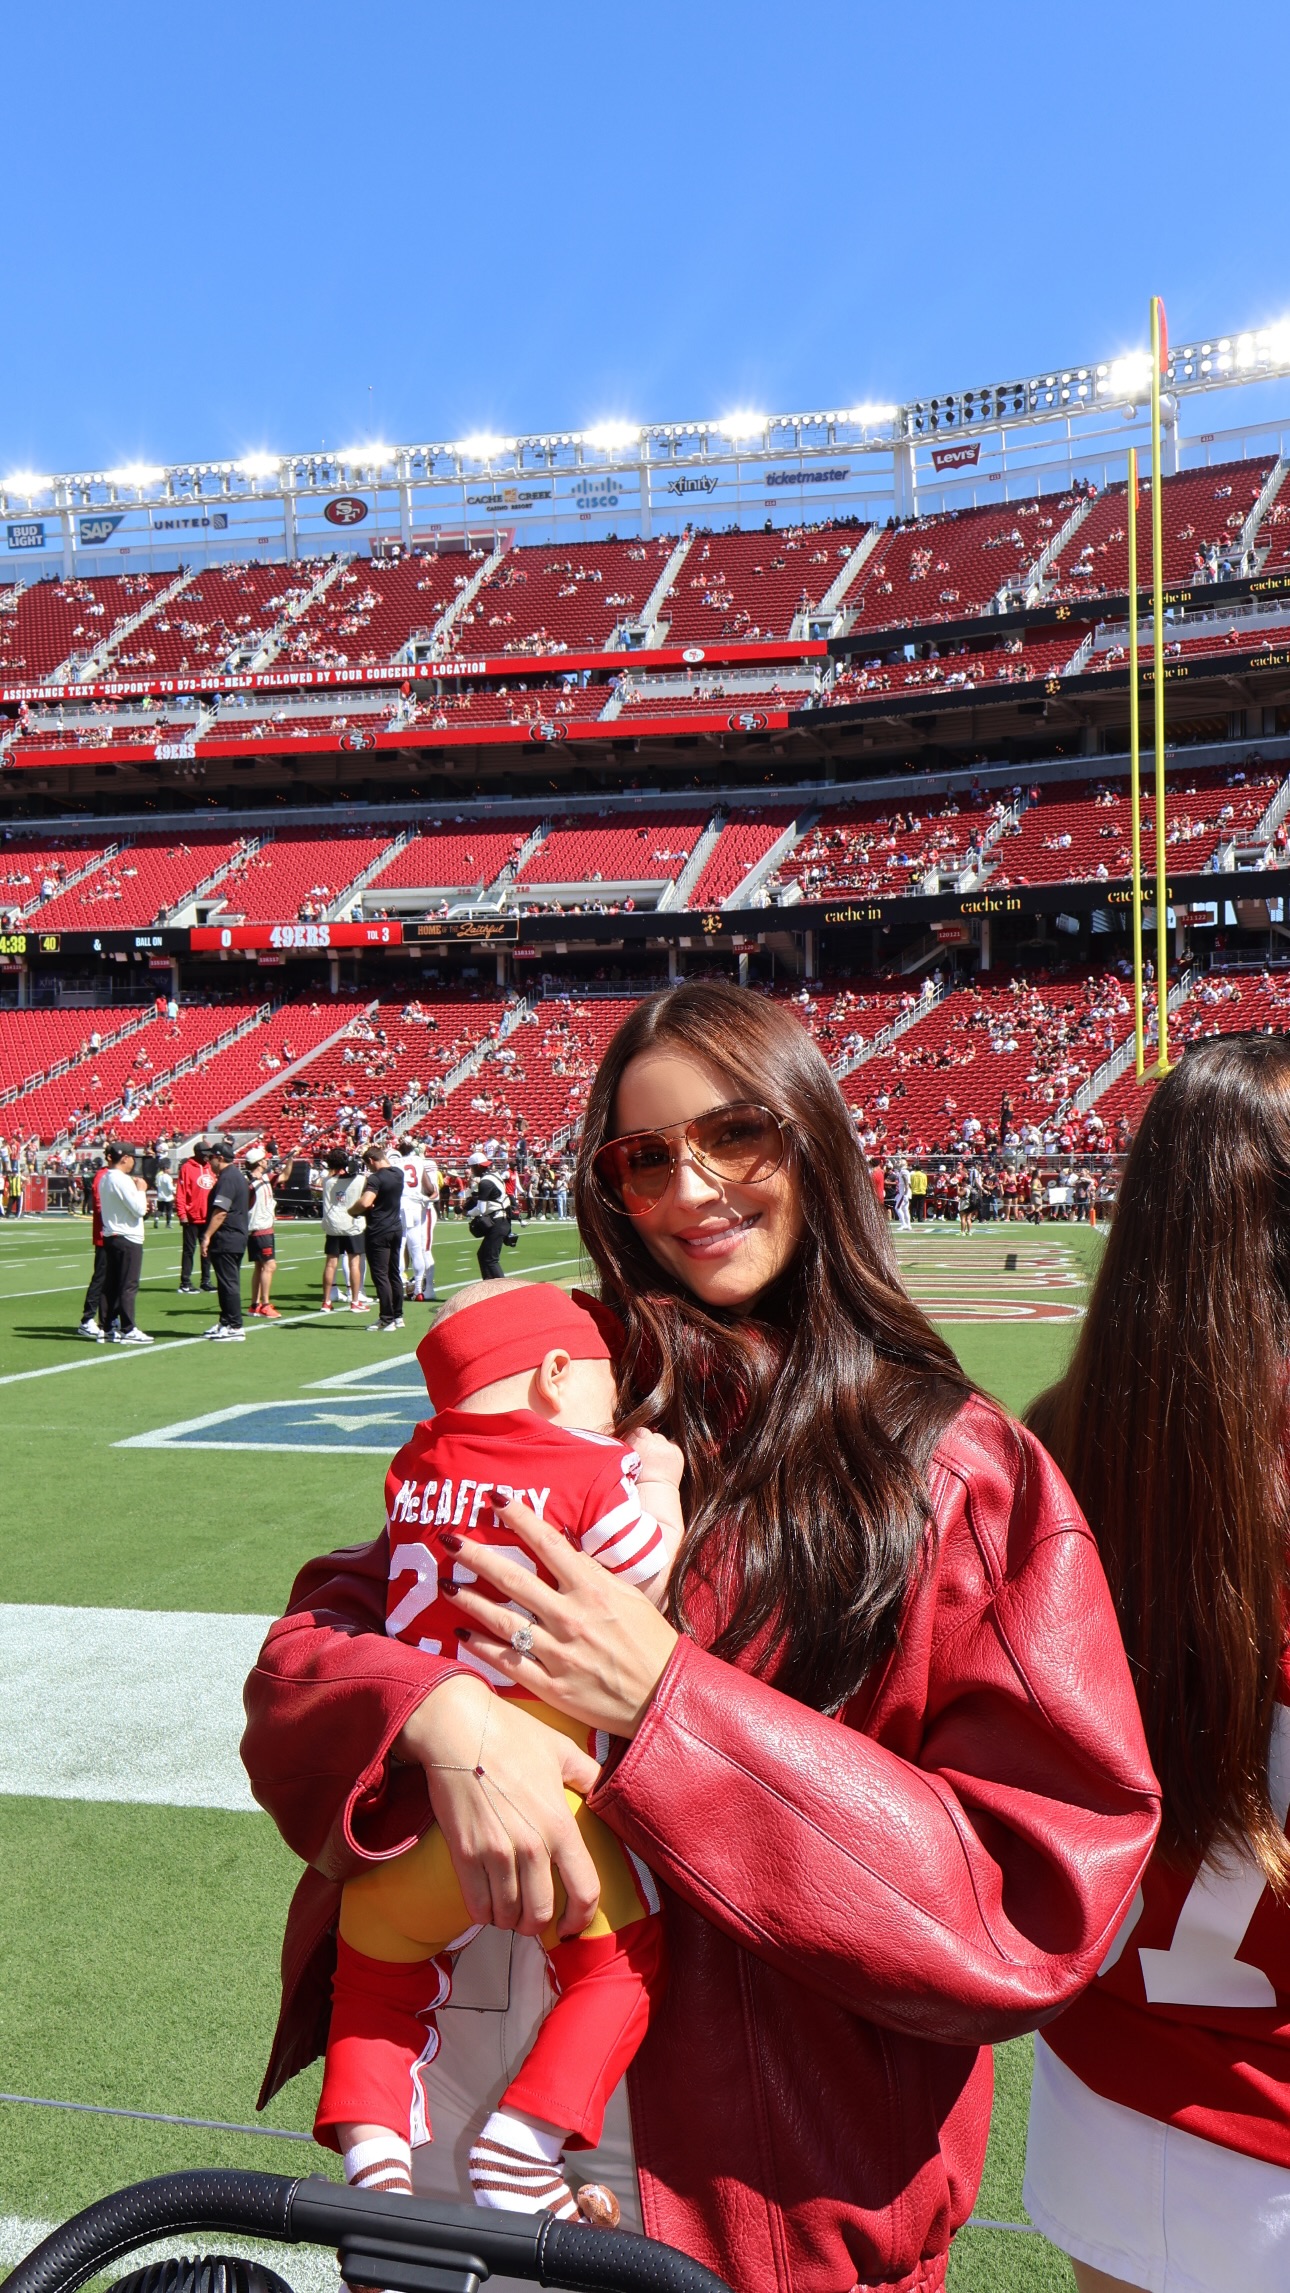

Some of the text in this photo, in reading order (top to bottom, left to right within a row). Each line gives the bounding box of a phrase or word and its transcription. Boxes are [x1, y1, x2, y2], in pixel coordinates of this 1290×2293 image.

[766, 468, 850, 486] ticketmaster
[668, 474, 718, 496] xfinity
[467, 491, 552, 505] CACHE CREEK
[576, 495, 619, 510] CISCO
[12, 525, 38, 537] BUD
[80, 521, 114, 540] SAP
[154, 517, 210, 530] UNITED
[8, 535, 43, 548] LIGHT
[1250, 577, 1282, 591] cache
[1181, 590, 1192, 602] in
[1250, 653, 1284, 667] cache
[1178, 664, 1188, 676] in
[3, 684, 64, 700] ASSISTANCE
[68, 685, 95, 696] TEXT
[160, 680, 174, 692] TO
[177, 676, 252, 690] 573-549-HELP
[256, 672, 313, 686] FOLLOWED
[317, 671, 330, 682] BY
[335, 668, 362, 681] YOUR
[366, 666, 416, 679] CONCERN
[420, 666, 428, 676] &
[432, 662, 486, 676] LOCATION
[154, 743, 196, 760] 49ERS
[960, 895, 1021, 913] cache in
[824, 904, 882, 923] cache in
[221, 924, 390, 948] 0 49ERS TOL 3
[418, 924, 441, 936] HOME
[456, 922, 505, 939] Faithful
[43, 937, 56, 950] 40
[93, 939, 102, 951] &
[135, 937, 152, 947] BALL
[152, 937, 162, 946] ON
